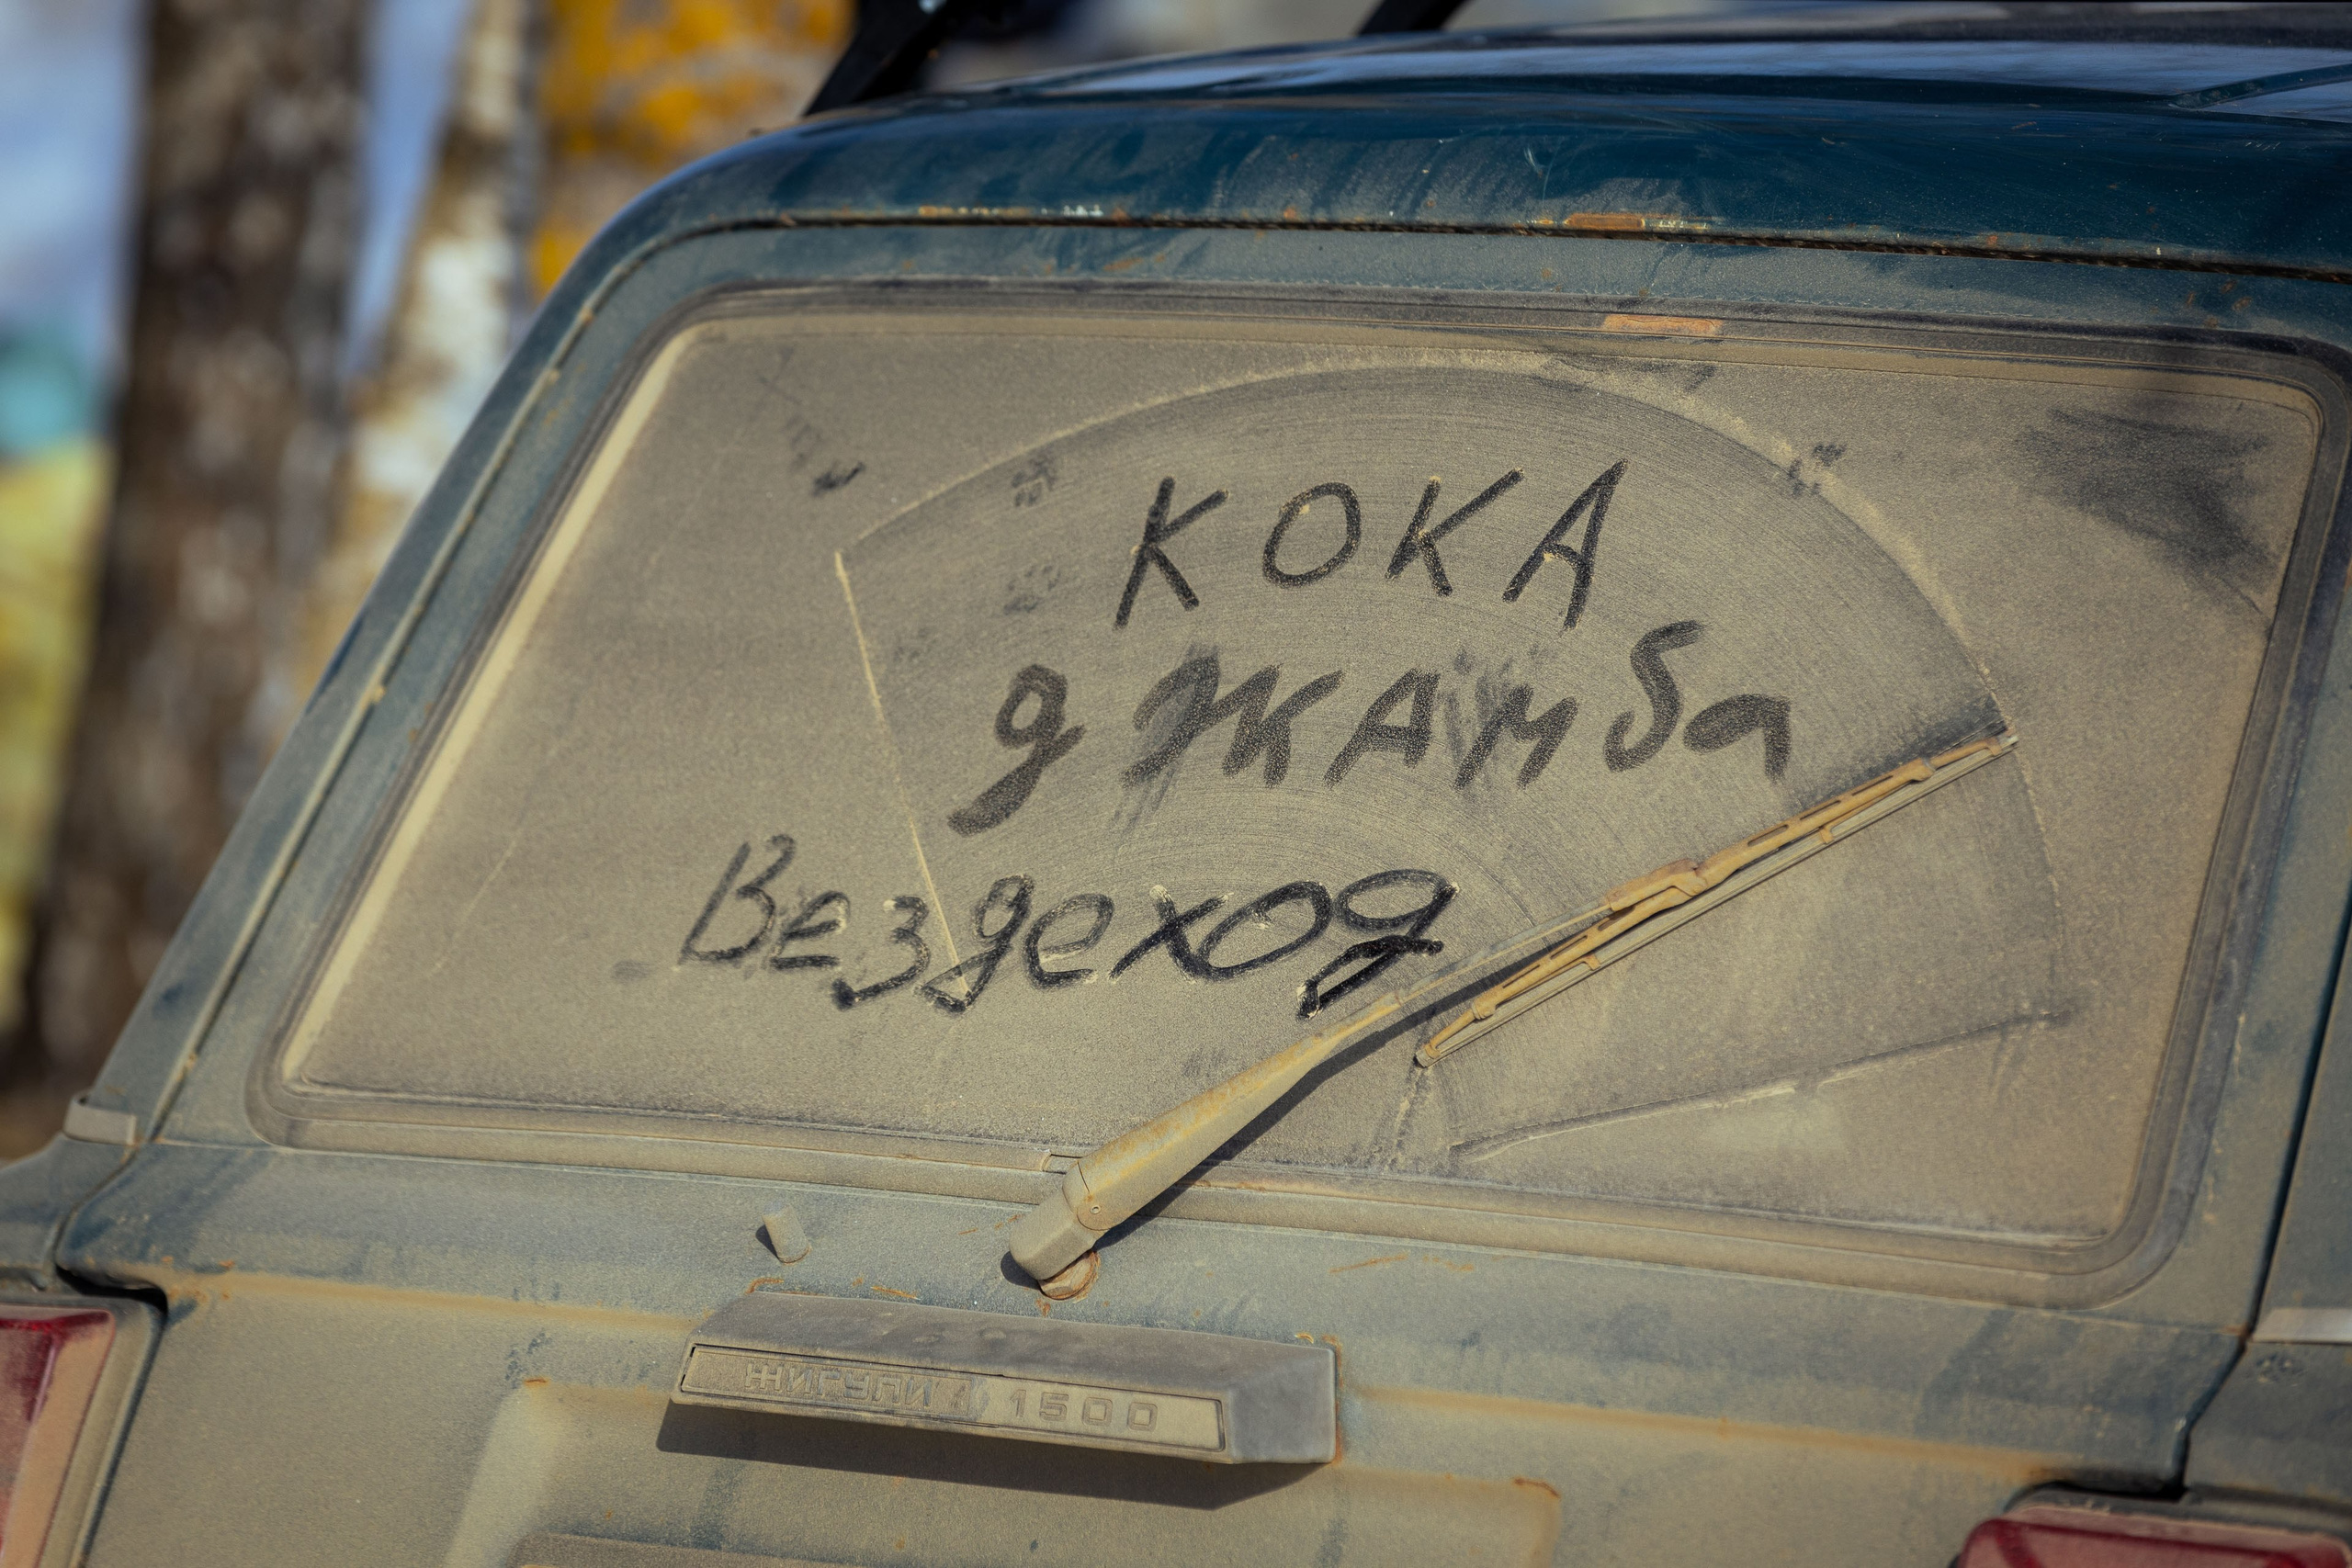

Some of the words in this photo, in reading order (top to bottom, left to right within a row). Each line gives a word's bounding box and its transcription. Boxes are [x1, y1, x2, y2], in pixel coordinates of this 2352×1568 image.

[1114, 459, 1629, 629] КОКА
[680, 834, 1456, 1019] Вездеход
[744, 1361, 933, 1406] ЖИГУЛИ
[1010, 1389, 1159, 1431] 1500
